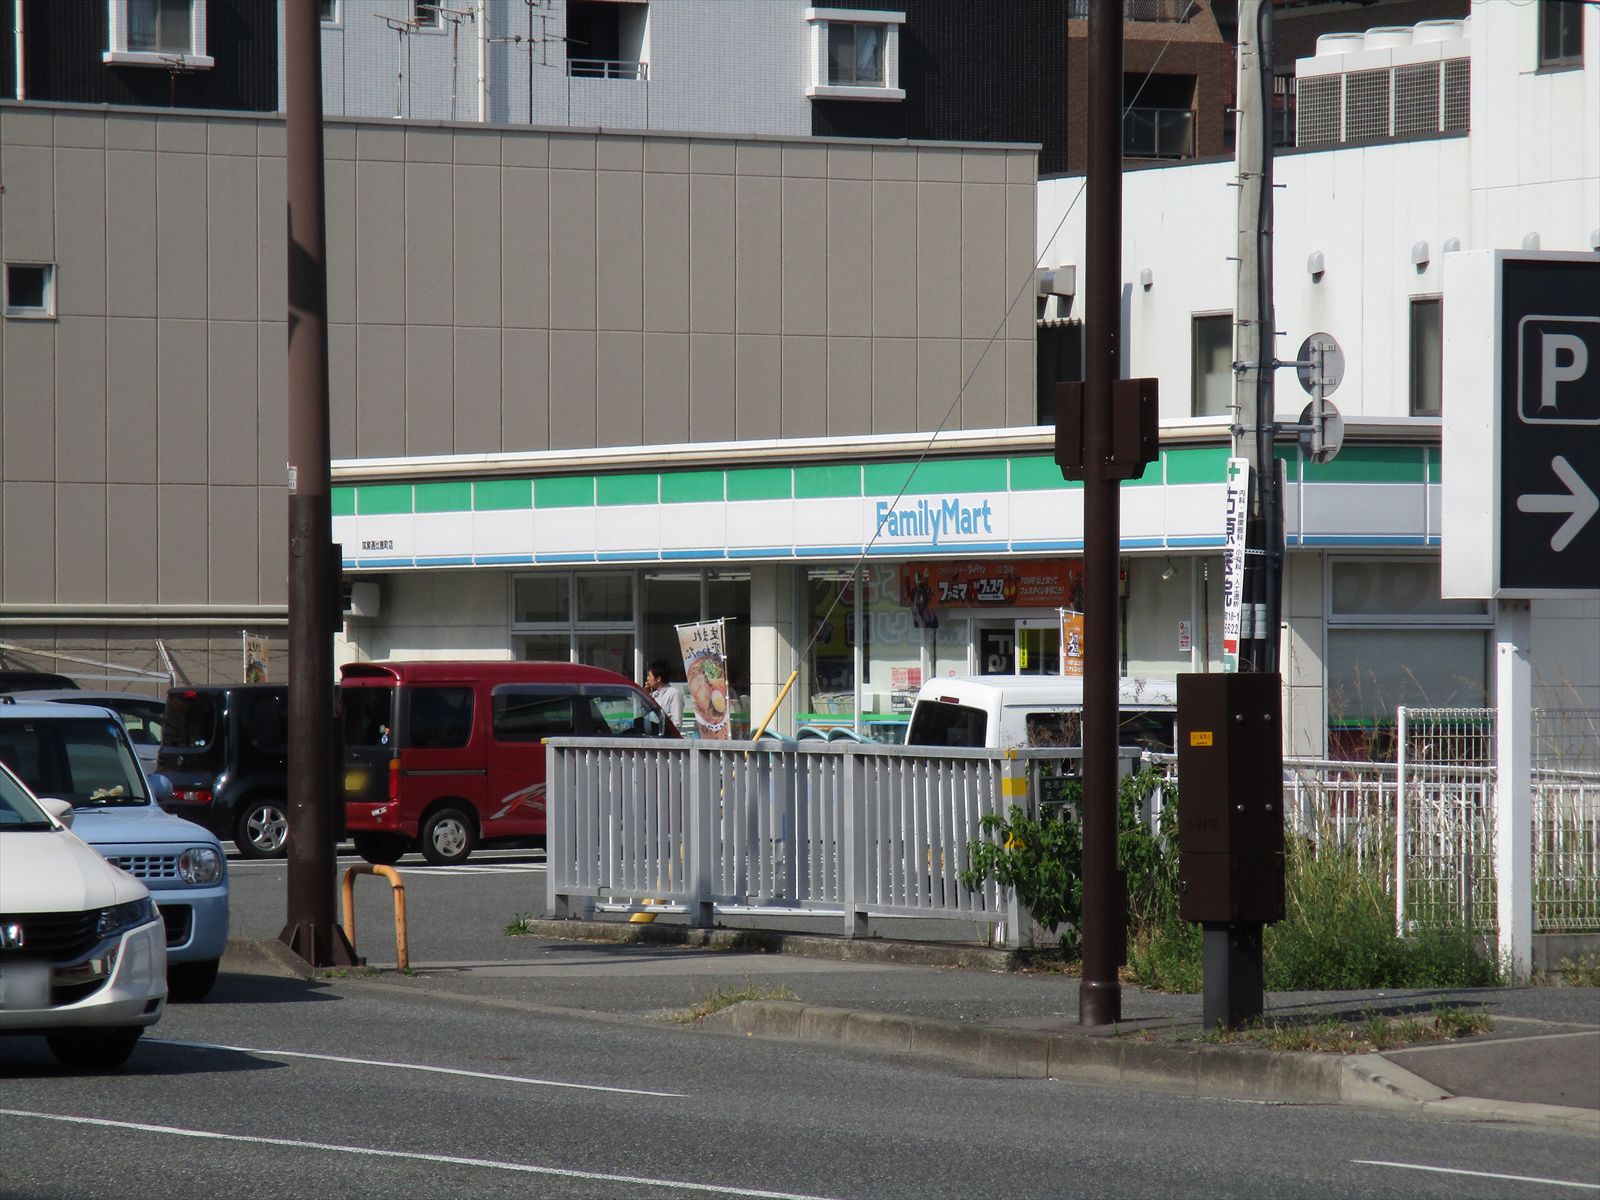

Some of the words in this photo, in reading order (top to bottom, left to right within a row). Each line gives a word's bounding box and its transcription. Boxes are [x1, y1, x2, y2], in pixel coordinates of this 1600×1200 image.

[1541, 334, 1589, 406] P
[876, 498, 992, 546] FamilyMart
[938, 581, 968, 601] ファミマ
